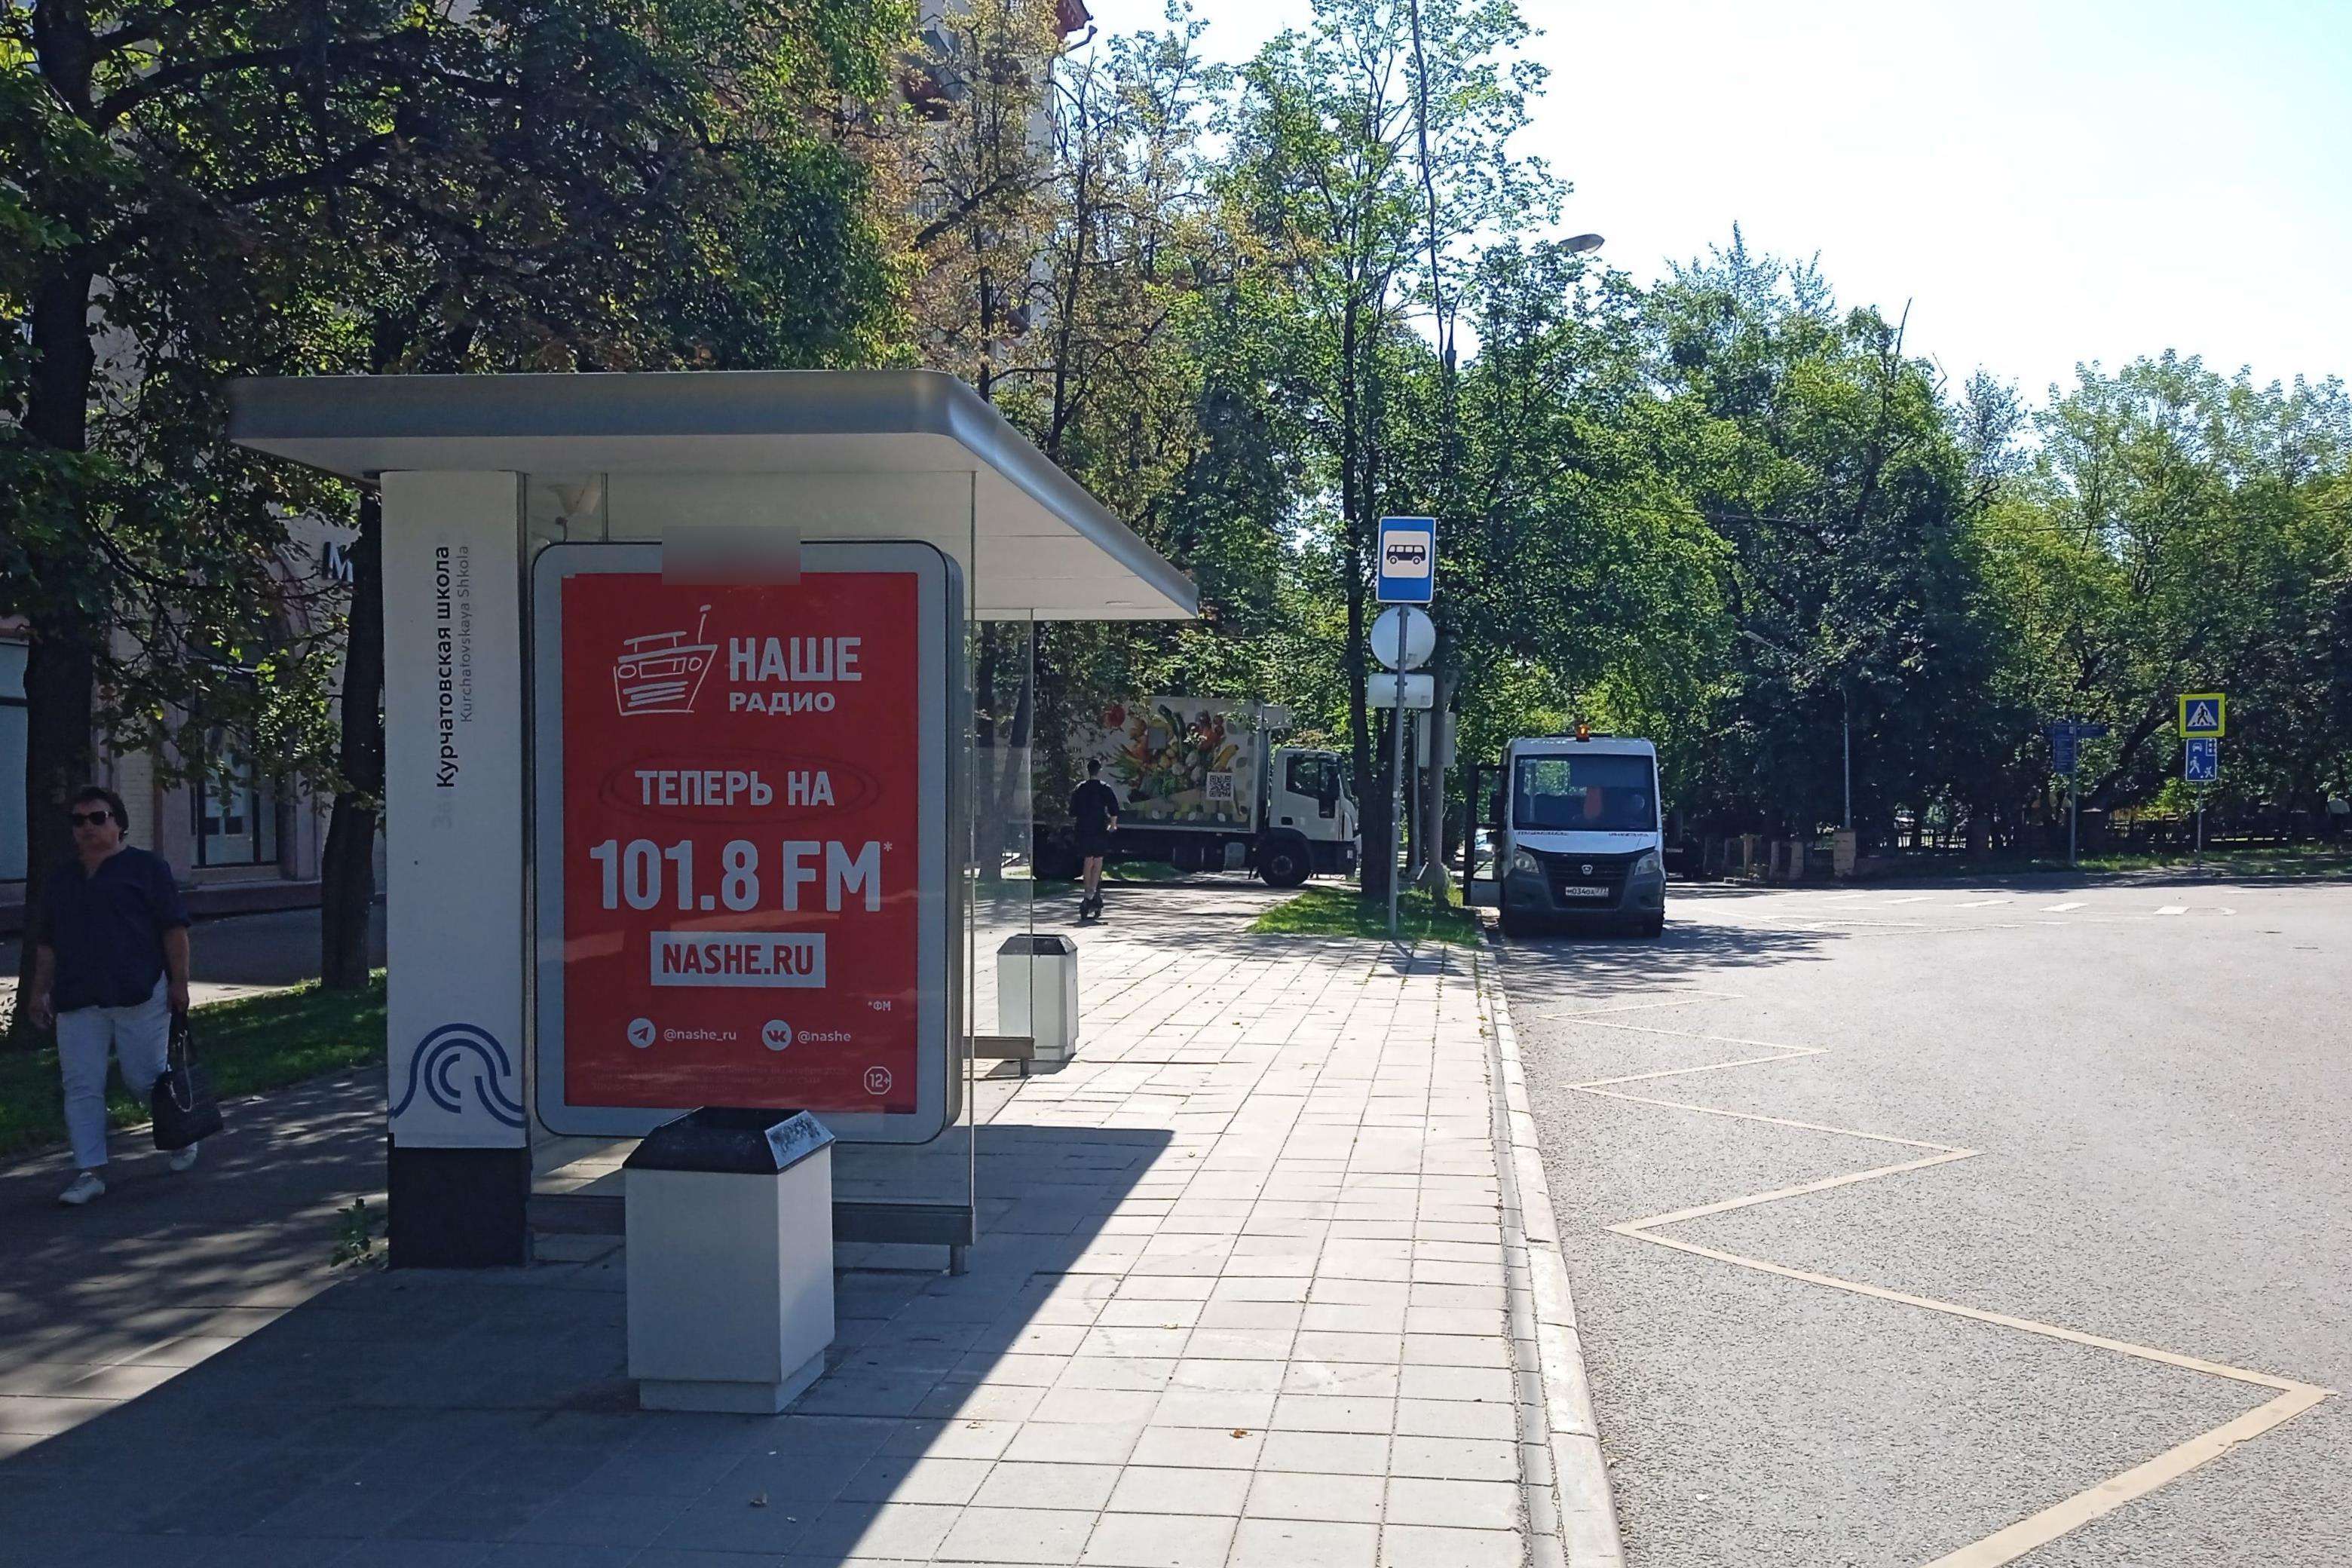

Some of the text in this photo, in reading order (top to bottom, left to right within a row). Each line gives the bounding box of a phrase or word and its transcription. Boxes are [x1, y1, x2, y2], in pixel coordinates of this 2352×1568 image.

[457, 545, 473, 722] Kurchatovskaya Shkola
[436, 547, 458, 787] Курчатовская школа
[730, 637, 862, 681] НАШЕ
[730, 692, 835, 715] РАДИО
[635, 770, 835, 806] ТЕПЕРЬ НА
[590, 839, 759, 911] 101.8
[663, 944, 813, 975] NASHE.RU
[663, 1028, 737, 1042] @nashe_ru
[798, 1031, 851, 1043] @nashe
[869, 1073, 891, 1088] 12+
